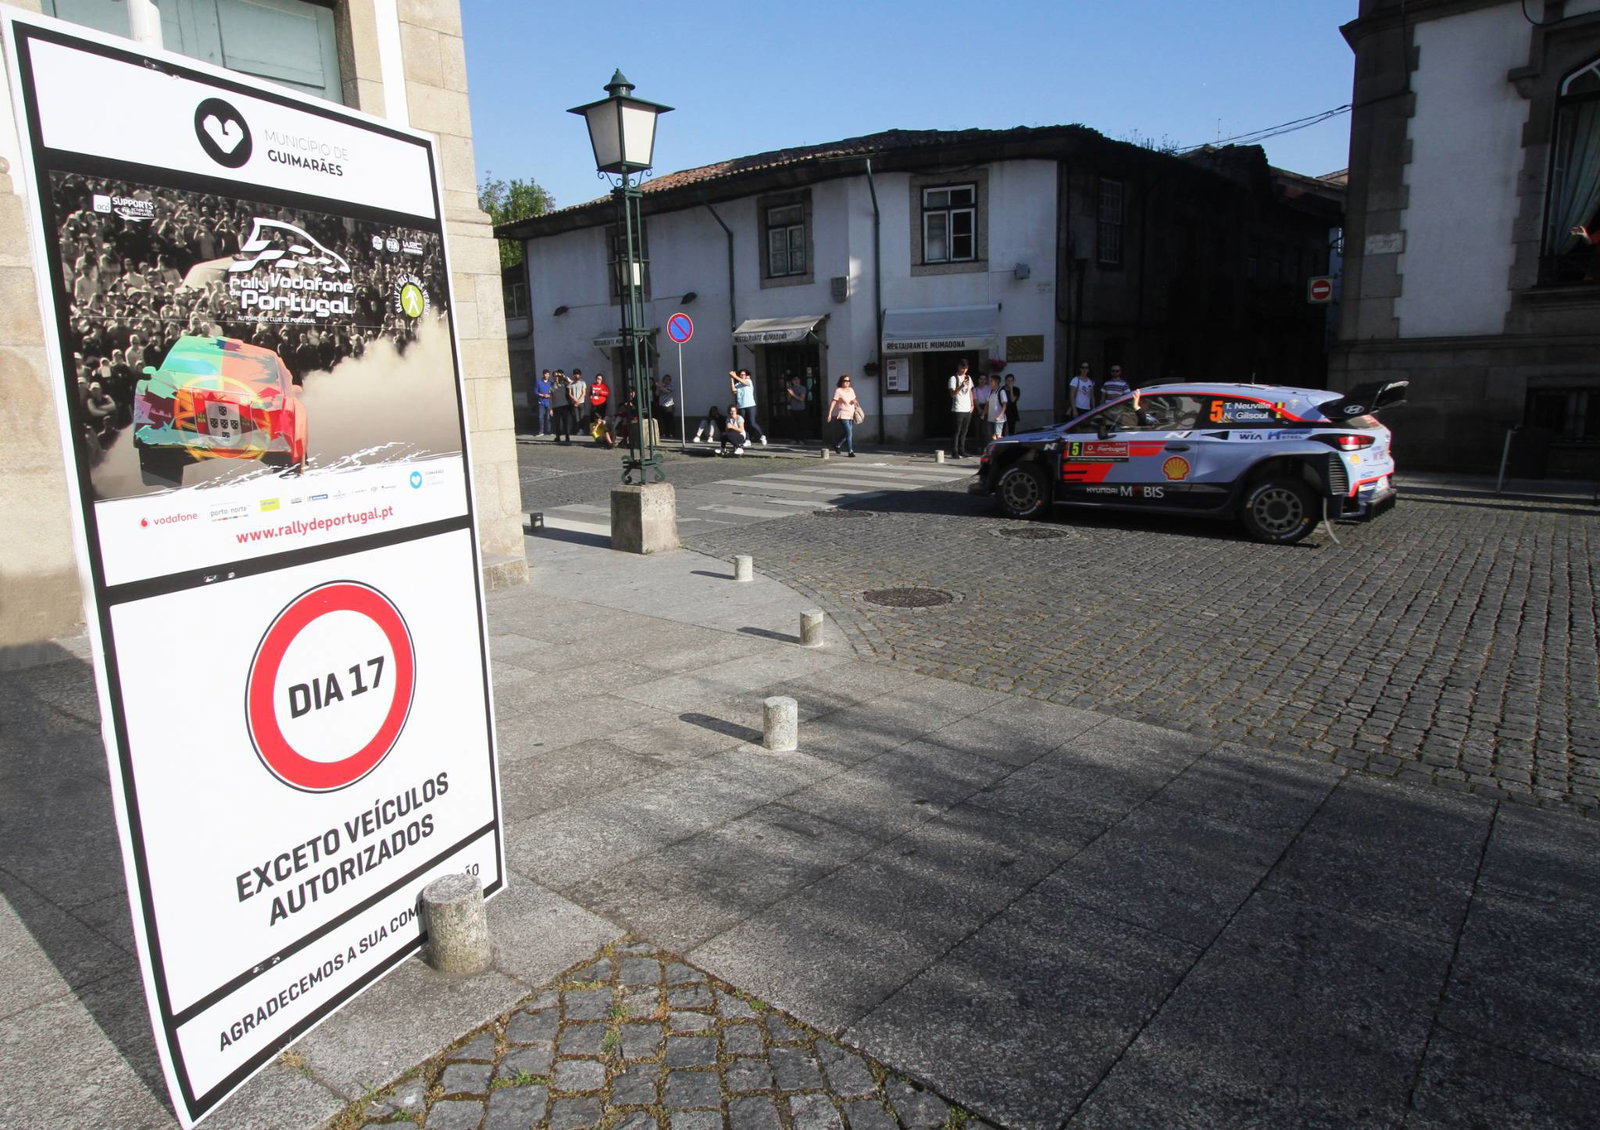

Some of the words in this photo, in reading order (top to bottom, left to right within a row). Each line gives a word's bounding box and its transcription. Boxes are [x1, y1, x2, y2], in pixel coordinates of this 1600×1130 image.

[267, 148, 344, 177] GUIMARÃES
[333, 146, 349, 162] DE
[112, 196, 154, 210] SUPPORTS
[269, 272, 354, 293] Vodafone
[241, 289, 354, 318] Portugal
[886, 341, 929, 350] RESTAURANTE
[929, 340, 966, 349] MUMADONA
[1209, 400, 1224, 423] 5
[1225, 402, 1233, 410] T.
[1235, 402, 1272, 410] Neuville
[1236, 411, 1269, 420] Gilsoul
[1072, 442, 1080, 456] 5
[153, 512, 199, 526] vodafone
[235, 506, 394, 544] www.rallydeportugal.pt
[288, 673, 345, 719] DIA
[347, 655, 386, 697] 17
[235, 828, 341, 902] EXCETO
[344, 771, 450, 845] VEÍCULOS
[269, 813, 435, 927] AUTORIZADOS
[219, 953, 345, 1052] AGRADECEMOS
[346, 946, 357, 965] A
[358, 925, 389, 955] SUA
